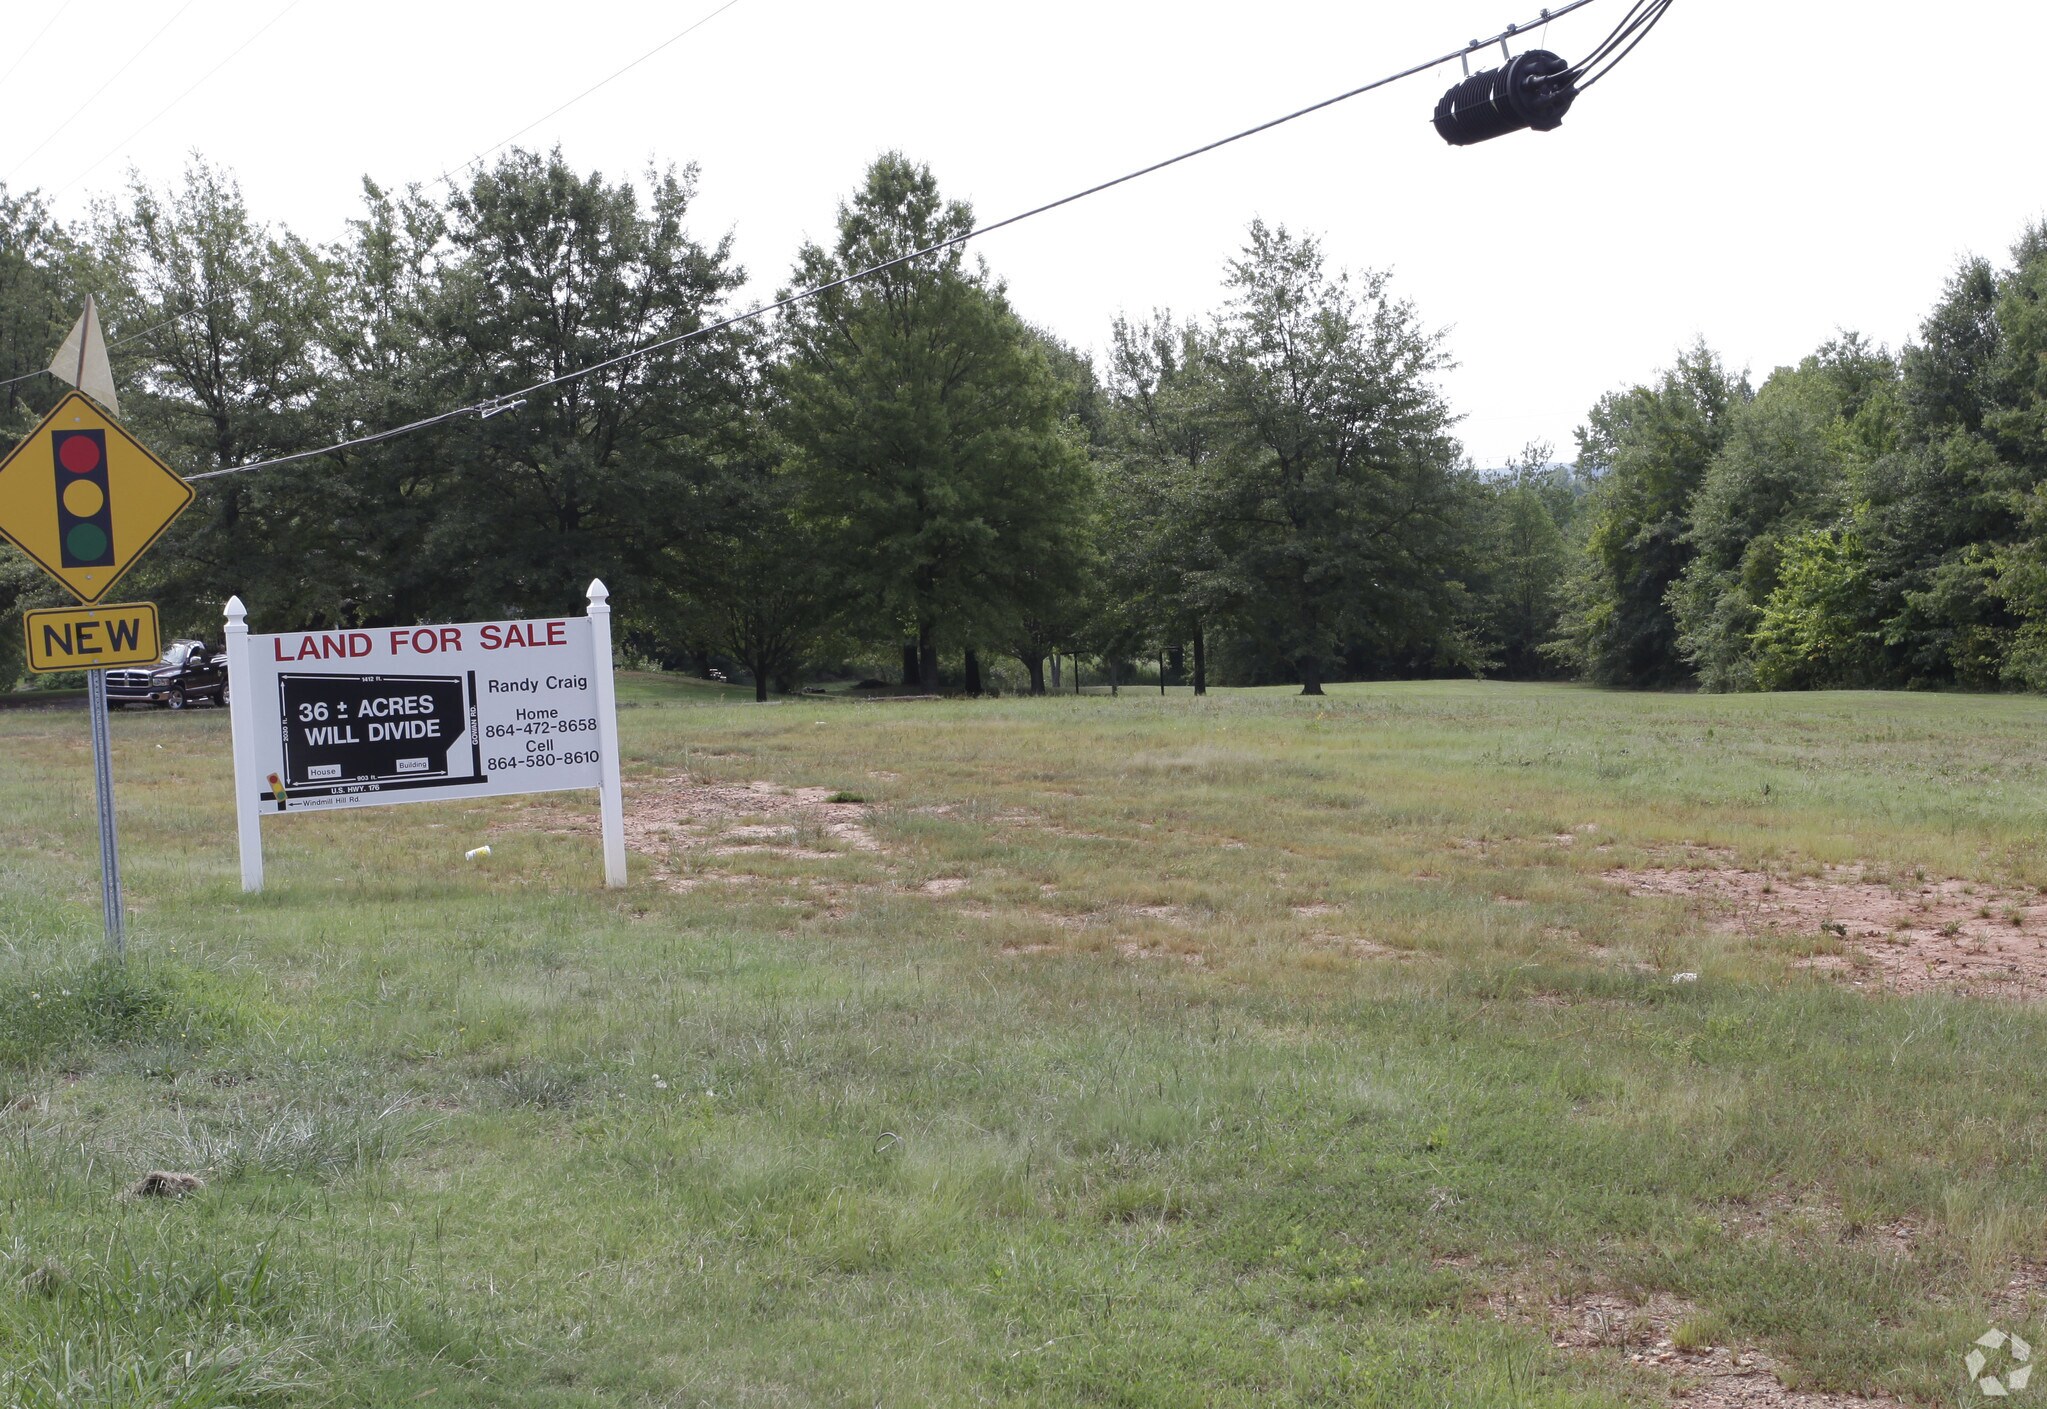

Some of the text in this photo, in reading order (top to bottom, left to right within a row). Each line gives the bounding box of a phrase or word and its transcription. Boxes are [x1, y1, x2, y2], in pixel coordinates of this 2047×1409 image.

[43, 618, 140, 657] NEW
[274, 621, 568, 662] LAND FOR SALE
[488, 675, 588, 693] Randy Craig
[298, 702, 329, 722] 36
[358, 695, 435, 718] ACRES
[516, 708, 558, 721] Home
[304, 719, 441, 746] WILL DIVIDE
[471, 718, 479, 745] GOWAN
[485, 718, 597, 738] 864-472-8658
[526, 739, 554, 753] Cell
[399, 761, 427, 770] Building
[487, 750, 600, 770] 864-580-8610
[310, 768, 336, 776] House
[331, 784, 380, 794] U.S. HWY. 176
[302, 798, 333, 807] Windmill
